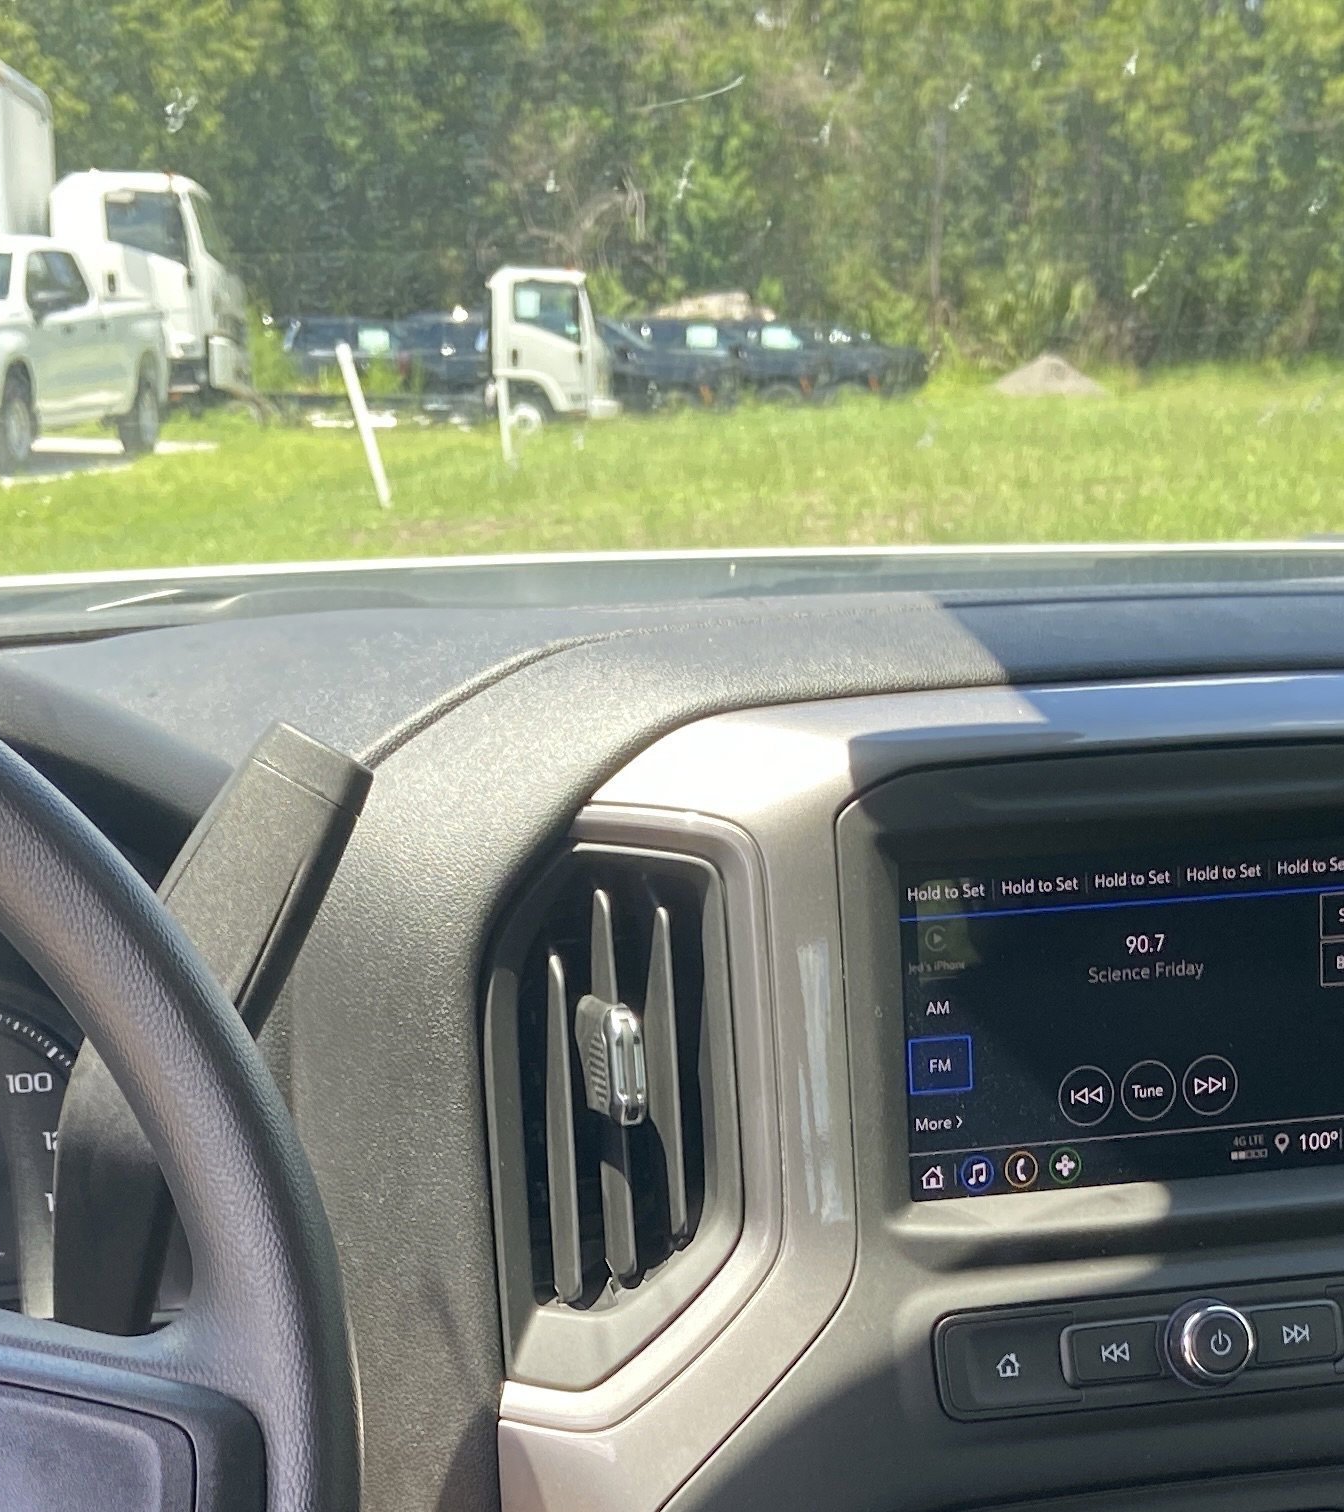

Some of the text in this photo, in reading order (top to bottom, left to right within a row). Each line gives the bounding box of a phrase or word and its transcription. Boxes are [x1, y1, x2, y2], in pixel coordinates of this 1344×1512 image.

[1186, 863, 1261, 882] Hold to Set
[1277, 859, 1309, 876] Hold
[1312, 859, 1326, 873] to
[1001, 876, 1078, 895] Hold to Set
[1094, 869, 1170, 889] Hold to Set
[907, 883, 985, 902] Hold to Set
[1125, 934, 1165, 954] 90.7
[1088, 960, 1204, 984] Science Friday
[926, 1001, 950, 1016] AM
[929, 1059, 951, 1073] FM
[6, 1071, 53, 1094] 100
[1132, 1083, 1164, 1099] Tune
[915, 1117, 952, 1132] More
[1233, 1134, 1264, 1147] 4G LTE
